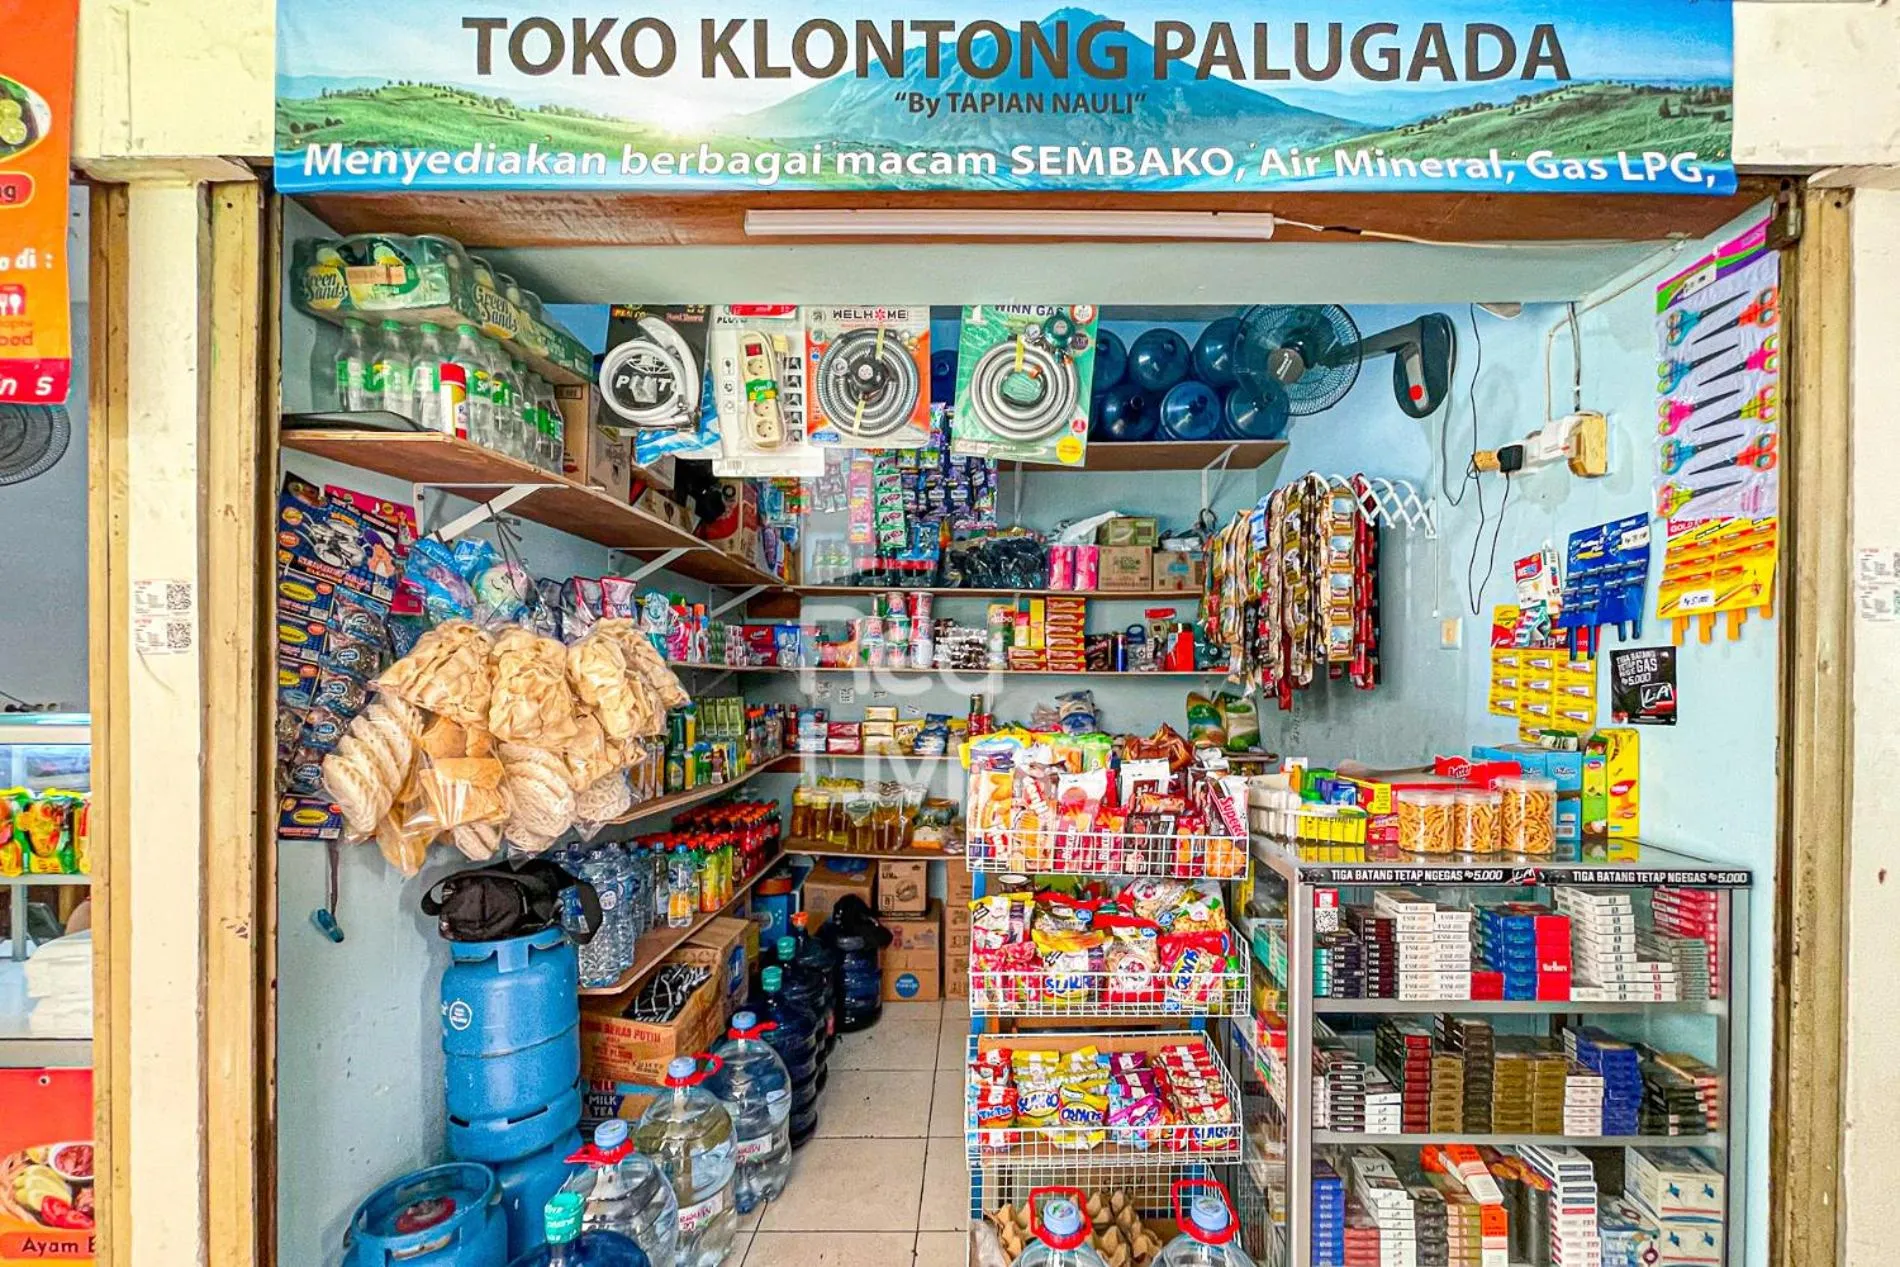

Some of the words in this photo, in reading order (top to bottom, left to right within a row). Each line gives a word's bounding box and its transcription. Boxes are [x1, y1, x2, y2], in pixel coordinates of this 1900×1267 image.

[462, 16, 677, 78] TOKO
[701, 17, 1129, 81] KLONTONG
[1154, 21, 1572, 83] PALUGADA
[947, 92, 1044, 115] TAPIAN
[303, 142, 607, 186] Menyediakan
[621, 143, 822, 187] berbagai
[836, 150, 997, 176] macam
[1011, 144, 1246, 184] SEMBAKO,
[1259, 147, 1321, 177] Air
[1333, 147, 1516, 184] Mineral,
[1526, 150, 1608, 181] Gas
[1620, 151, 1716, 188] LPG,
[474, 281, 509, 313] Green
[481, 303, 518, 333] Sands
[1636, 658, 1658, 673] GAS
[1331, 869, 1353, 881] TIGA
[1356, 869, 1393, 882] BATANG
[1395, 869, 1423, 881] TETAP
[1424, 869, 1464, 881] NGEGAS
[1573, 870, 1594, 882] TIGA
[1597, 871, 1635, 883] BATANG
[1636, 871, 1666, 883] TETAP
[1667, 871, 1707, 883] NGEGAS
[589, 1095, 617, 1106] MILK
[22, 1236, 79, 1258] Ayam
